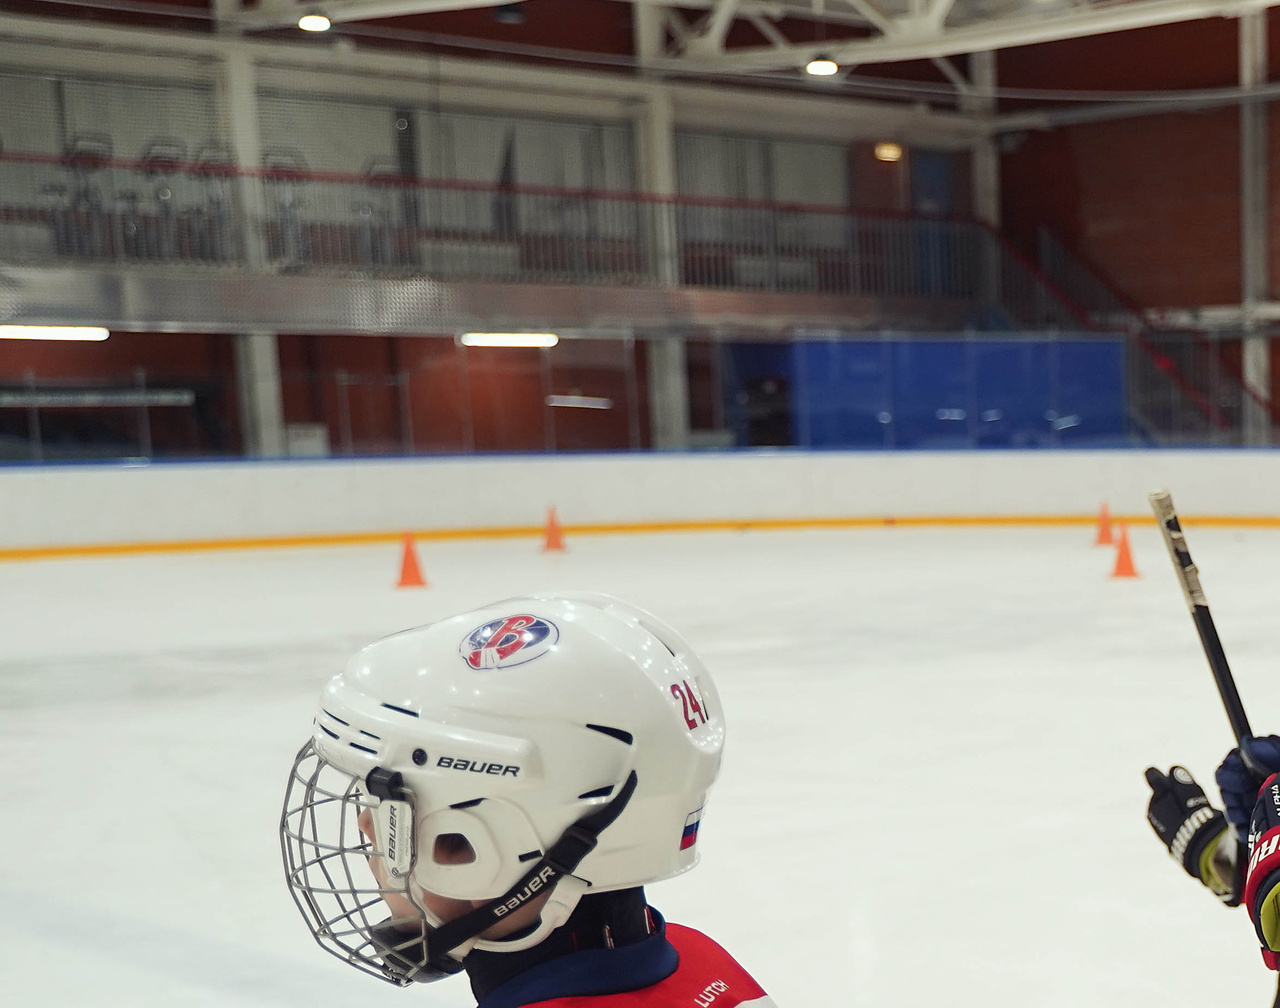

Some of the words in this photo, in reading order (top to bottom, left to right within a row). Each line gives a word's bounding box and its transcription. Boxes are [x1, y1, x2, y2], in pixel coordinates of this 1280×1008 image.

[670, 679, 707, 731] 24
[436, 755, 521, 778] BAUER
[388, 804, 398, 861] BAUER
[493, 865, 556, 918] BAUER
[694, 979, 730, 1008] LUTCH
